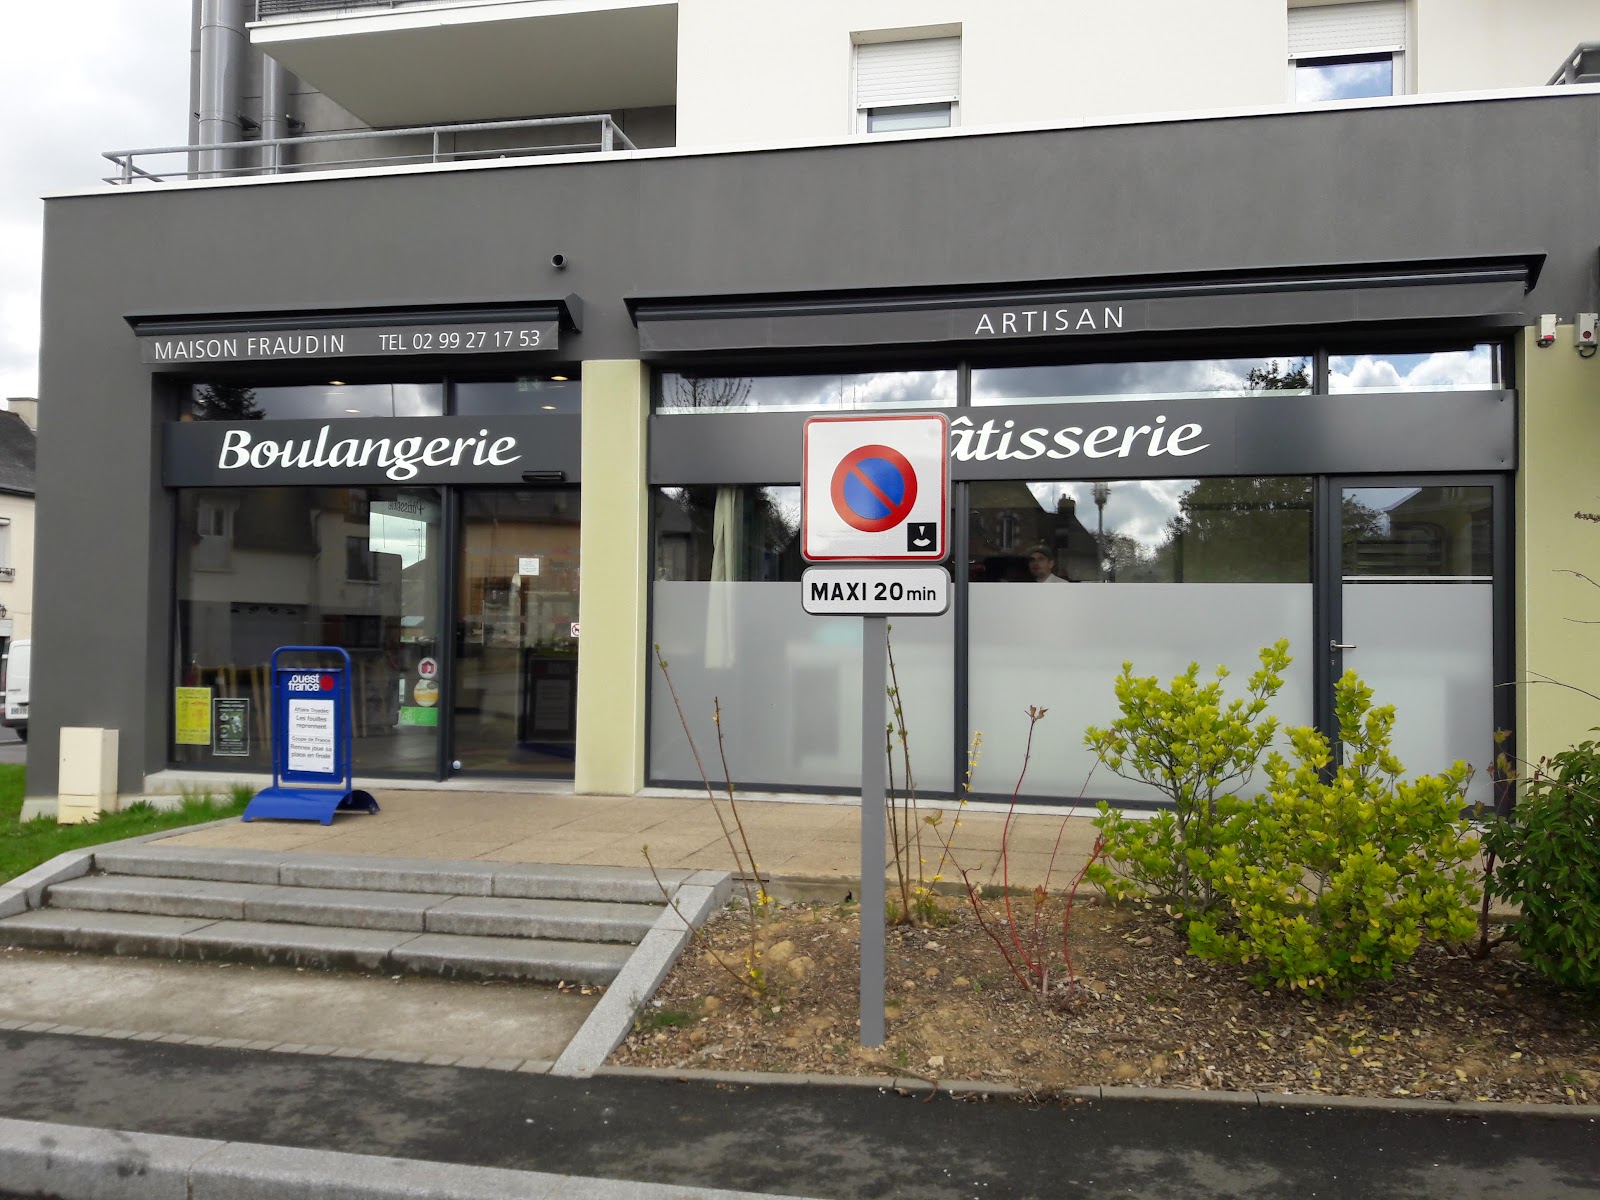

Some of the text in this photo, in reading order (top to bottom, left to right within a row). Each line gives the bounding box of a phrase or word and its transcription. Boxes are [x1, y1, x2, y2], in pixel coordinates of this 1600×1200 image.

[974, 306, 1124, 335] ARTISAN
[154, 329, 540, 360] MAISON FRAUDIN TEL 02 99 27 17 53
[218, 424, 522, 481] Boulangerie
[951, 415, 1211, 462] âtisserie
[811, 582, 936, 601] MAXI 20 min
[287, 680, 320, 691] france
[291, 674, 320, 683] ouest
